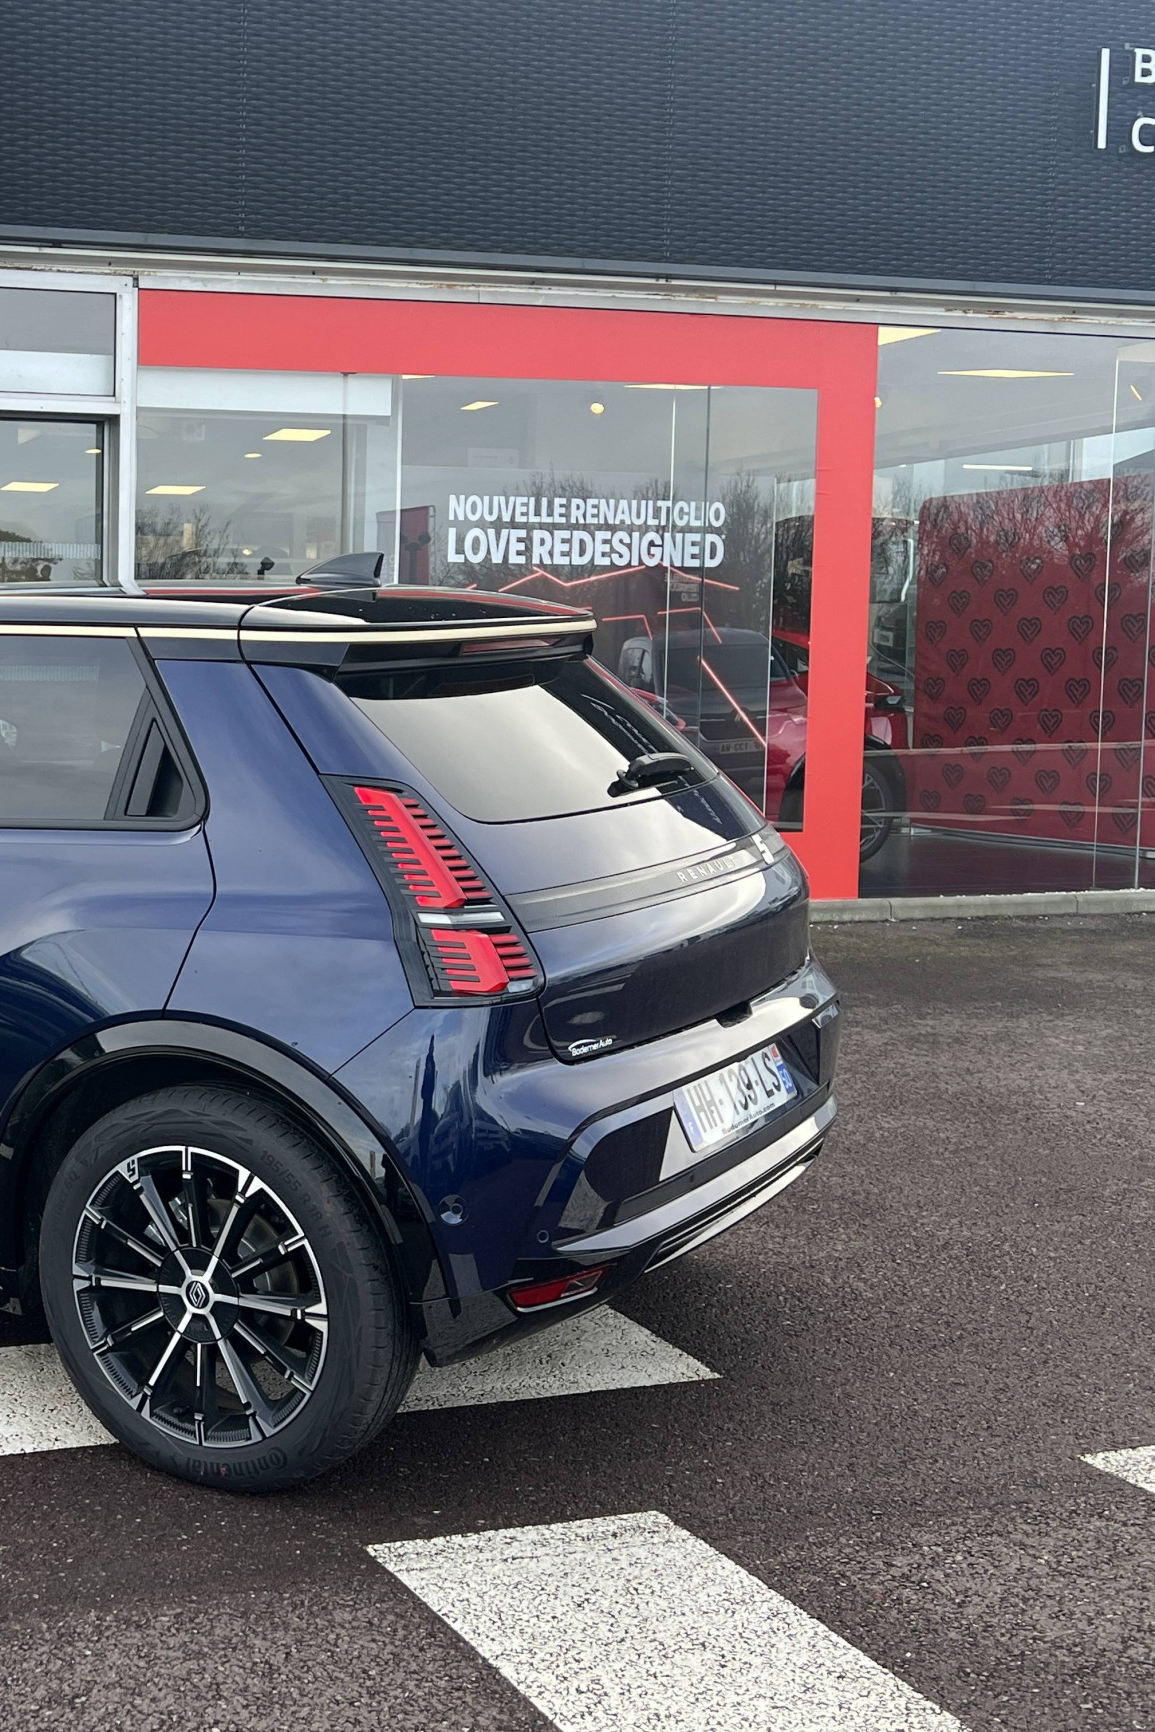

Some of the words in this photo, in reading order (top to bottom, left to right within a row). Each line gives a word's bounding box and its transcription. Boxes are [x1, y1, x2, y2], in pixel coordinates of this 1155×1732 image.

[448, 494, 566, 524] NOUVELLE
[570, 498, 670, 526] RENAULT
[673, 501, 726, 528] CLIO
[447, 527, 527, 564] LOVE
[676, 855, 736, 883] RENAULT
[686, 1051, 782, 1133] HH-139-LS
[260, 1150, 302, 1191] 195/55
[186, 1446, 288, 1480] Continental
